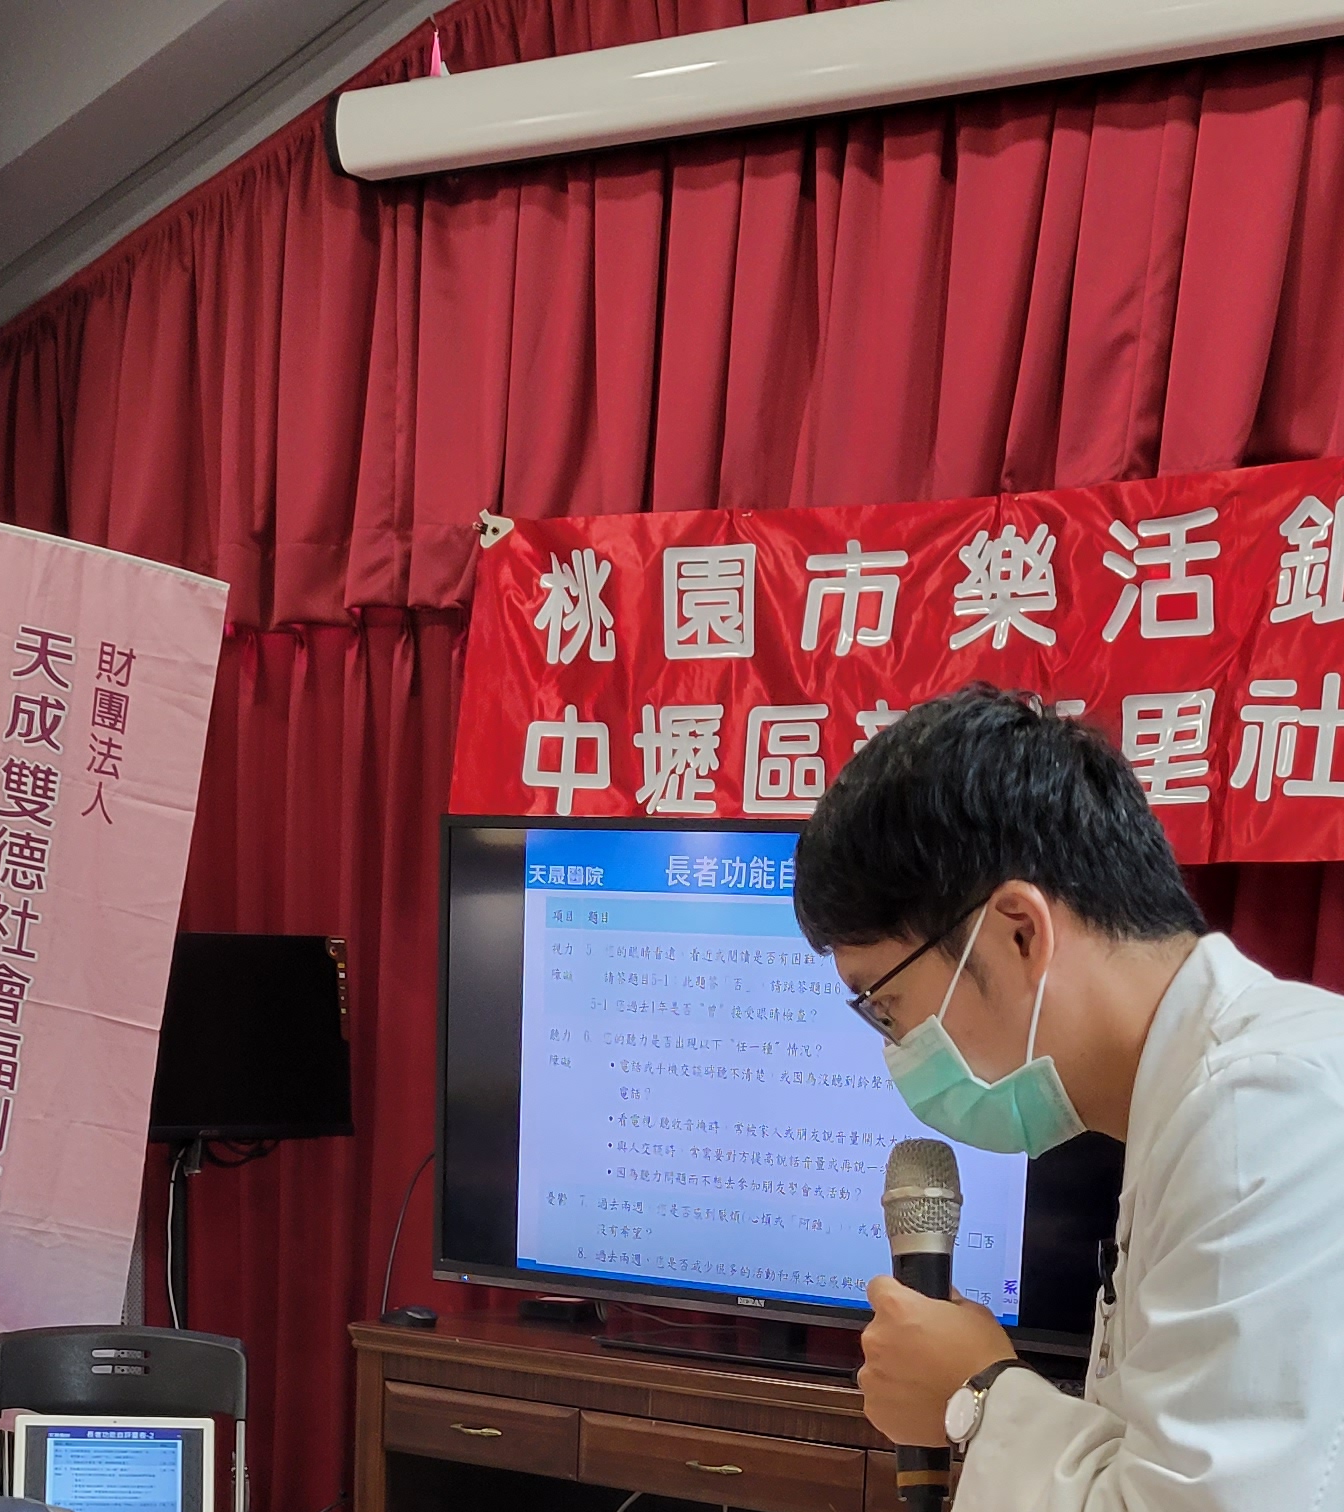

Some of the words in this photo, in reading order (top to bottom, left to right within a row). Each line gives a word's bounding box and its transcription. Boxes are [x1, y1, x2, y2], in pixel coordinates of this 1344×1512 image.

[80, 640, 136, 827] 財團法人
[528, 864, 605, 887] 天晟醫院
[664, 854, 796, 889] 長者功能自
[552, 909, 574, 923] 項目
[587, 910, 609, 924] 題目
